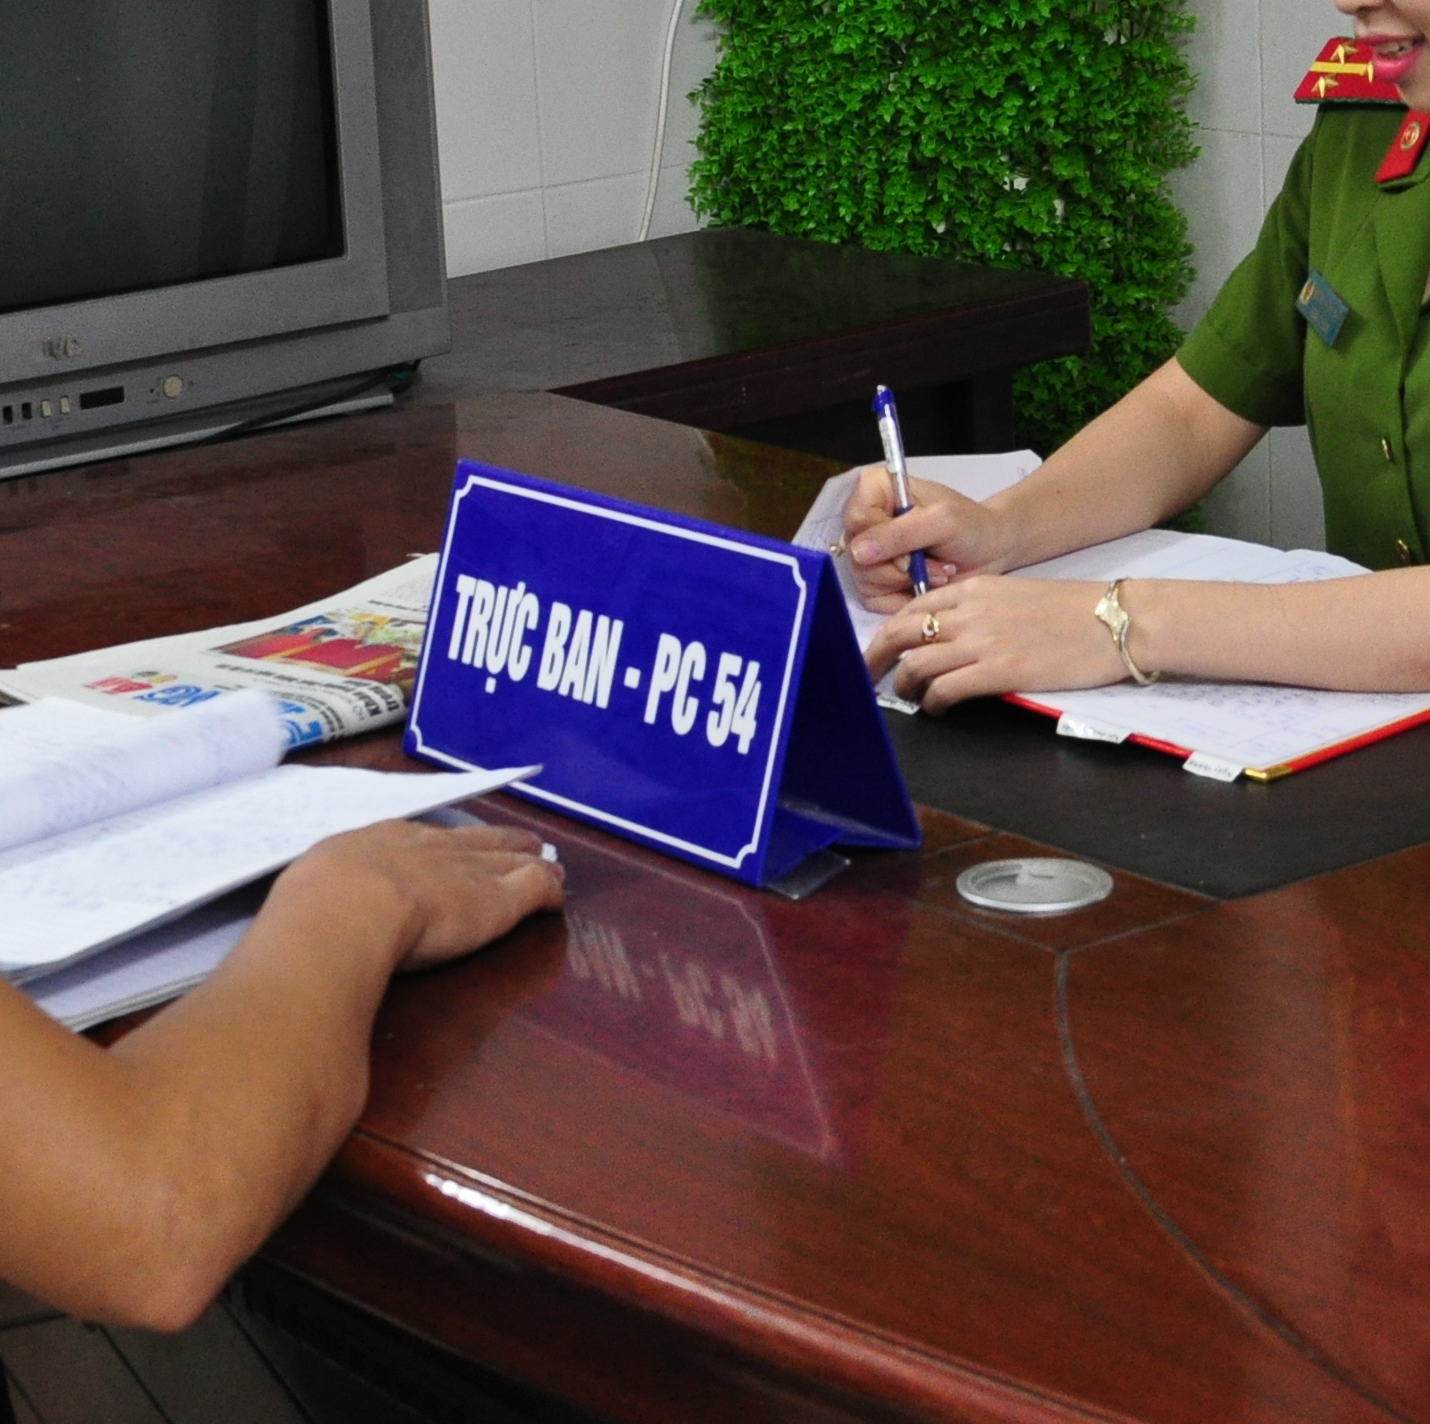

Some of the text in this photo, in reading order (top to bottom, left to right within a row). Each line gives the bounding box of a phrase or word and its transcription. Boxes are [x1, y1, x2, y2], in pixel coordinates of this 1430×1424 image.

[448, 573, 763, 756] TRỰC BAN - PC 54
